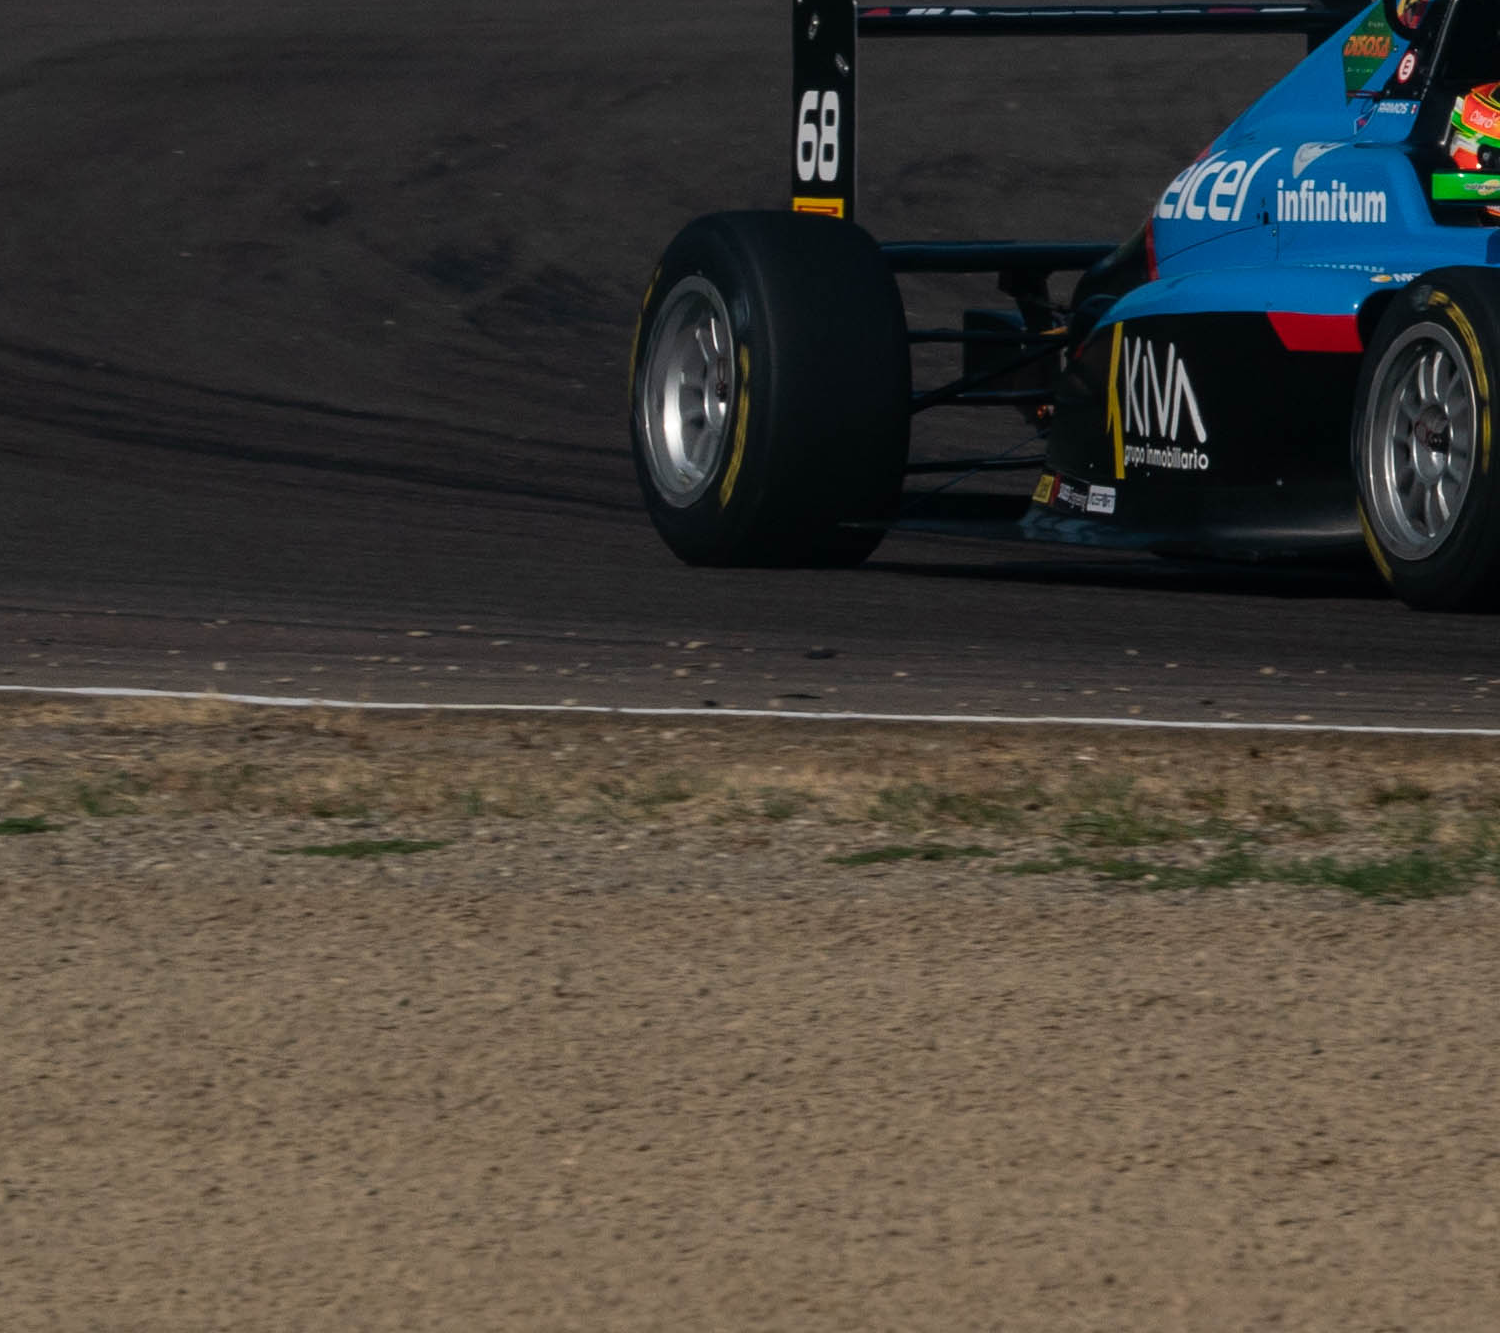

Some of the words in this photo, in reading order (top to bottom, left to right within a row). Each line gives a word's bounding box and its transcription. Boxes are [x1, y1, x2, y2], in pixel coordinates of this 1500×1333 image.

[796, 90, 840, 182] 68
[1153, 147, 1282, 222] elcel
[1276, 179, 1387, 223] infinitum
[1123, 335, 1207, 443] KIVA
[1124, 444, 1145, 467] grupo
[1146, 443, 1209, 470] inmobiliario
